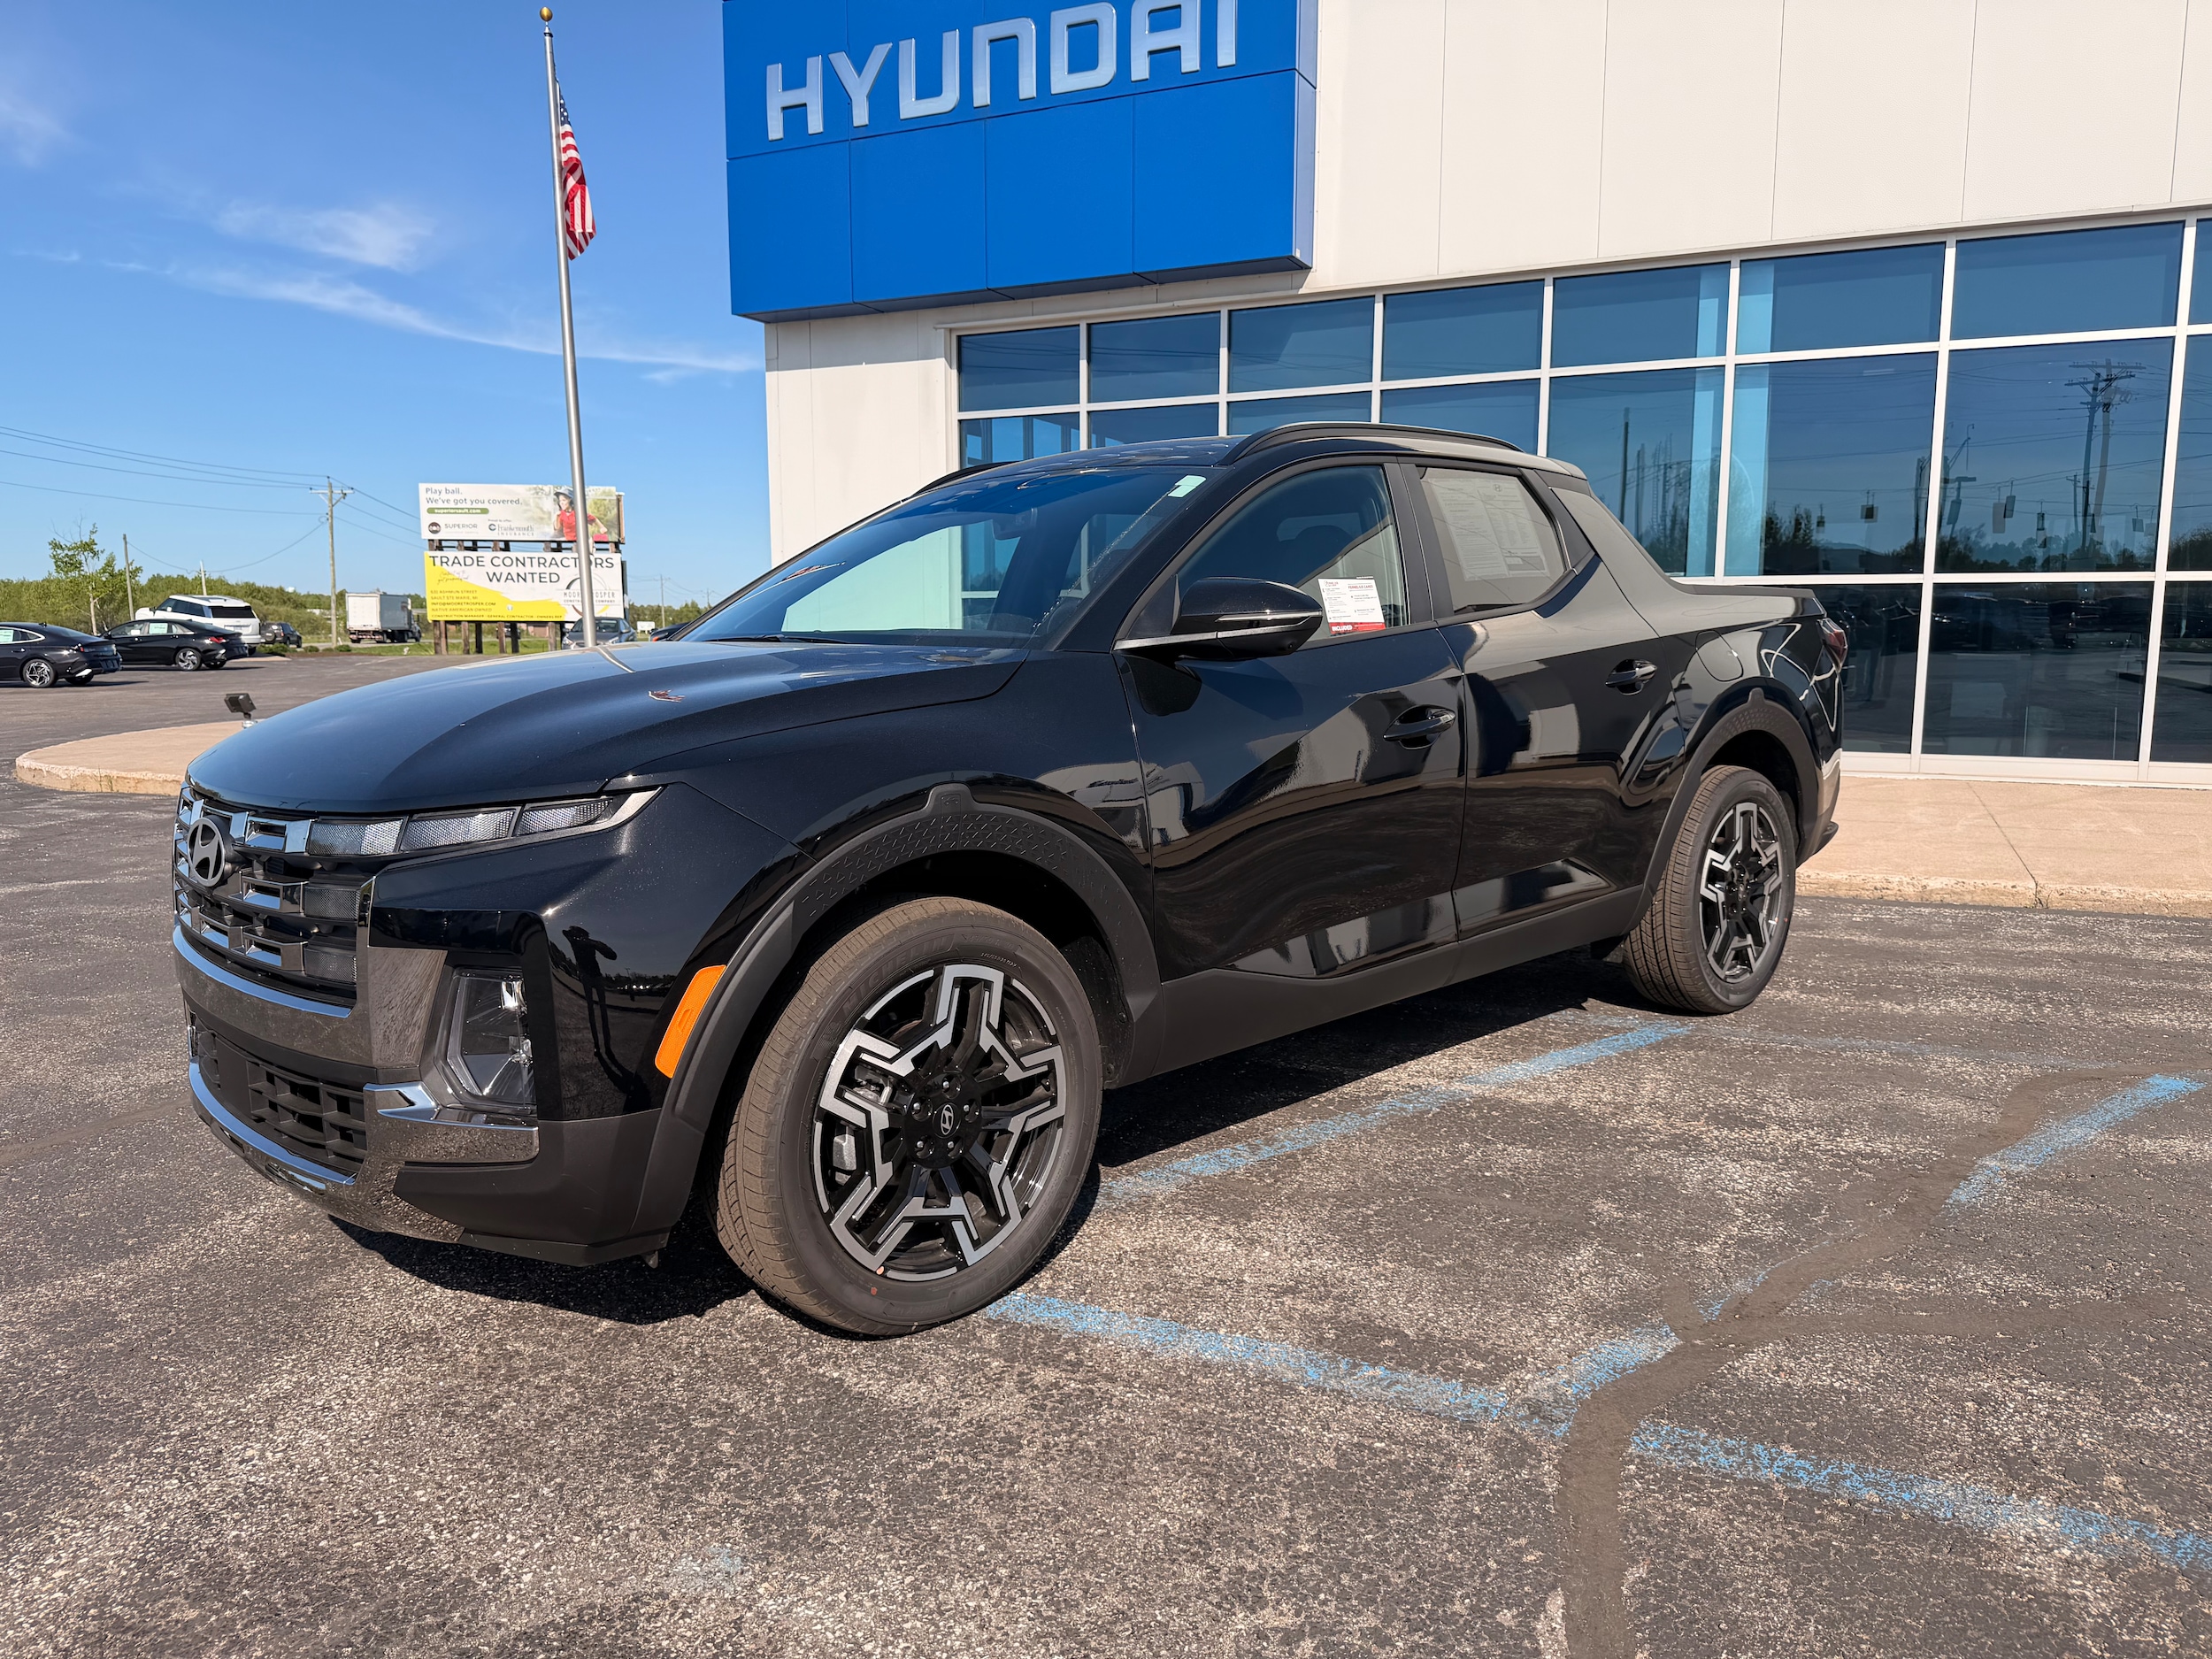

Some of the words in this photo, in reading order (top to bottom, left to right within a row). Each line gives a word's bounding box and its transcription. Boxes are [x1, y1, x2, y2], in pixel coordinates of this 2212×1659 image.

[766, 0, 1236, 142] HYUNDAI
[426, 487, 442, 496] Play
[445, 487, 463, 495] ball.
[453, 497, 468, 506] got
[429, 556, 485, 567] TRADE
[490, 556, 614, 569] CONTRACTRS
[486, 572, 560, 584] WANTED
[841, 935, 947, 1018] MICHELIN
